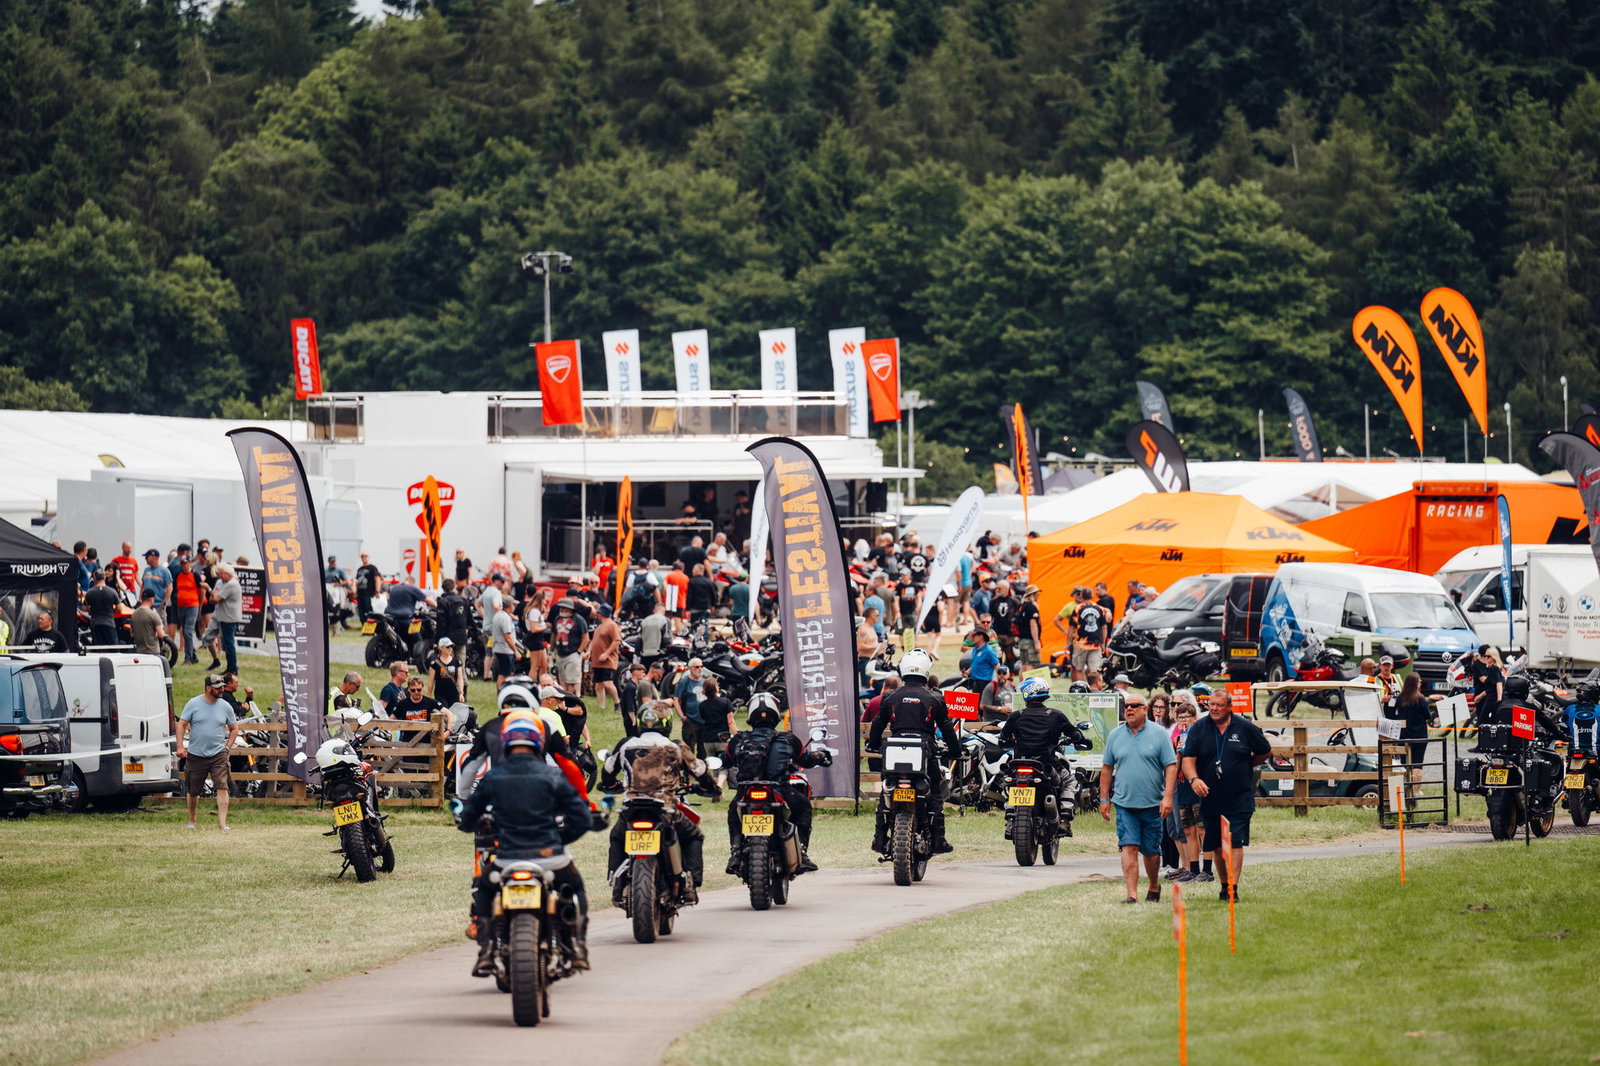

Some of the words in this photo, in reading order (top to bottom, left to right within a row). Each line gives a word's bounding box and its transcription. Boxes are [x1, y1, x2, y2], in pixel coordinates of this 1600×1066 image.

[296, 326, 313, 392] DUCATI
[1126, 518, 1179, 531] KTM
[1247, 527, 1304, 541] KTM
[1063, 546, 1085, 558] KTM
[1160, 548, 1183, 561] KTM
[1275, 552, 1305, 564] KTM
[11, 564, 57, 577] TRIUMPH
[955, 696, 966, 704] NO
[1519, 713, 1527, 721] NO
[1513, 721, 1533, 732] PARKING
[337, 803, 358, 815] LN17
[340, 811, 359, 822] YMX
[744, 815, 772, 825] LC20
[748, 825, 768, 833] YXF
[630, 831, 655, 841] DX71
[631, 842, 653, 852] URF
